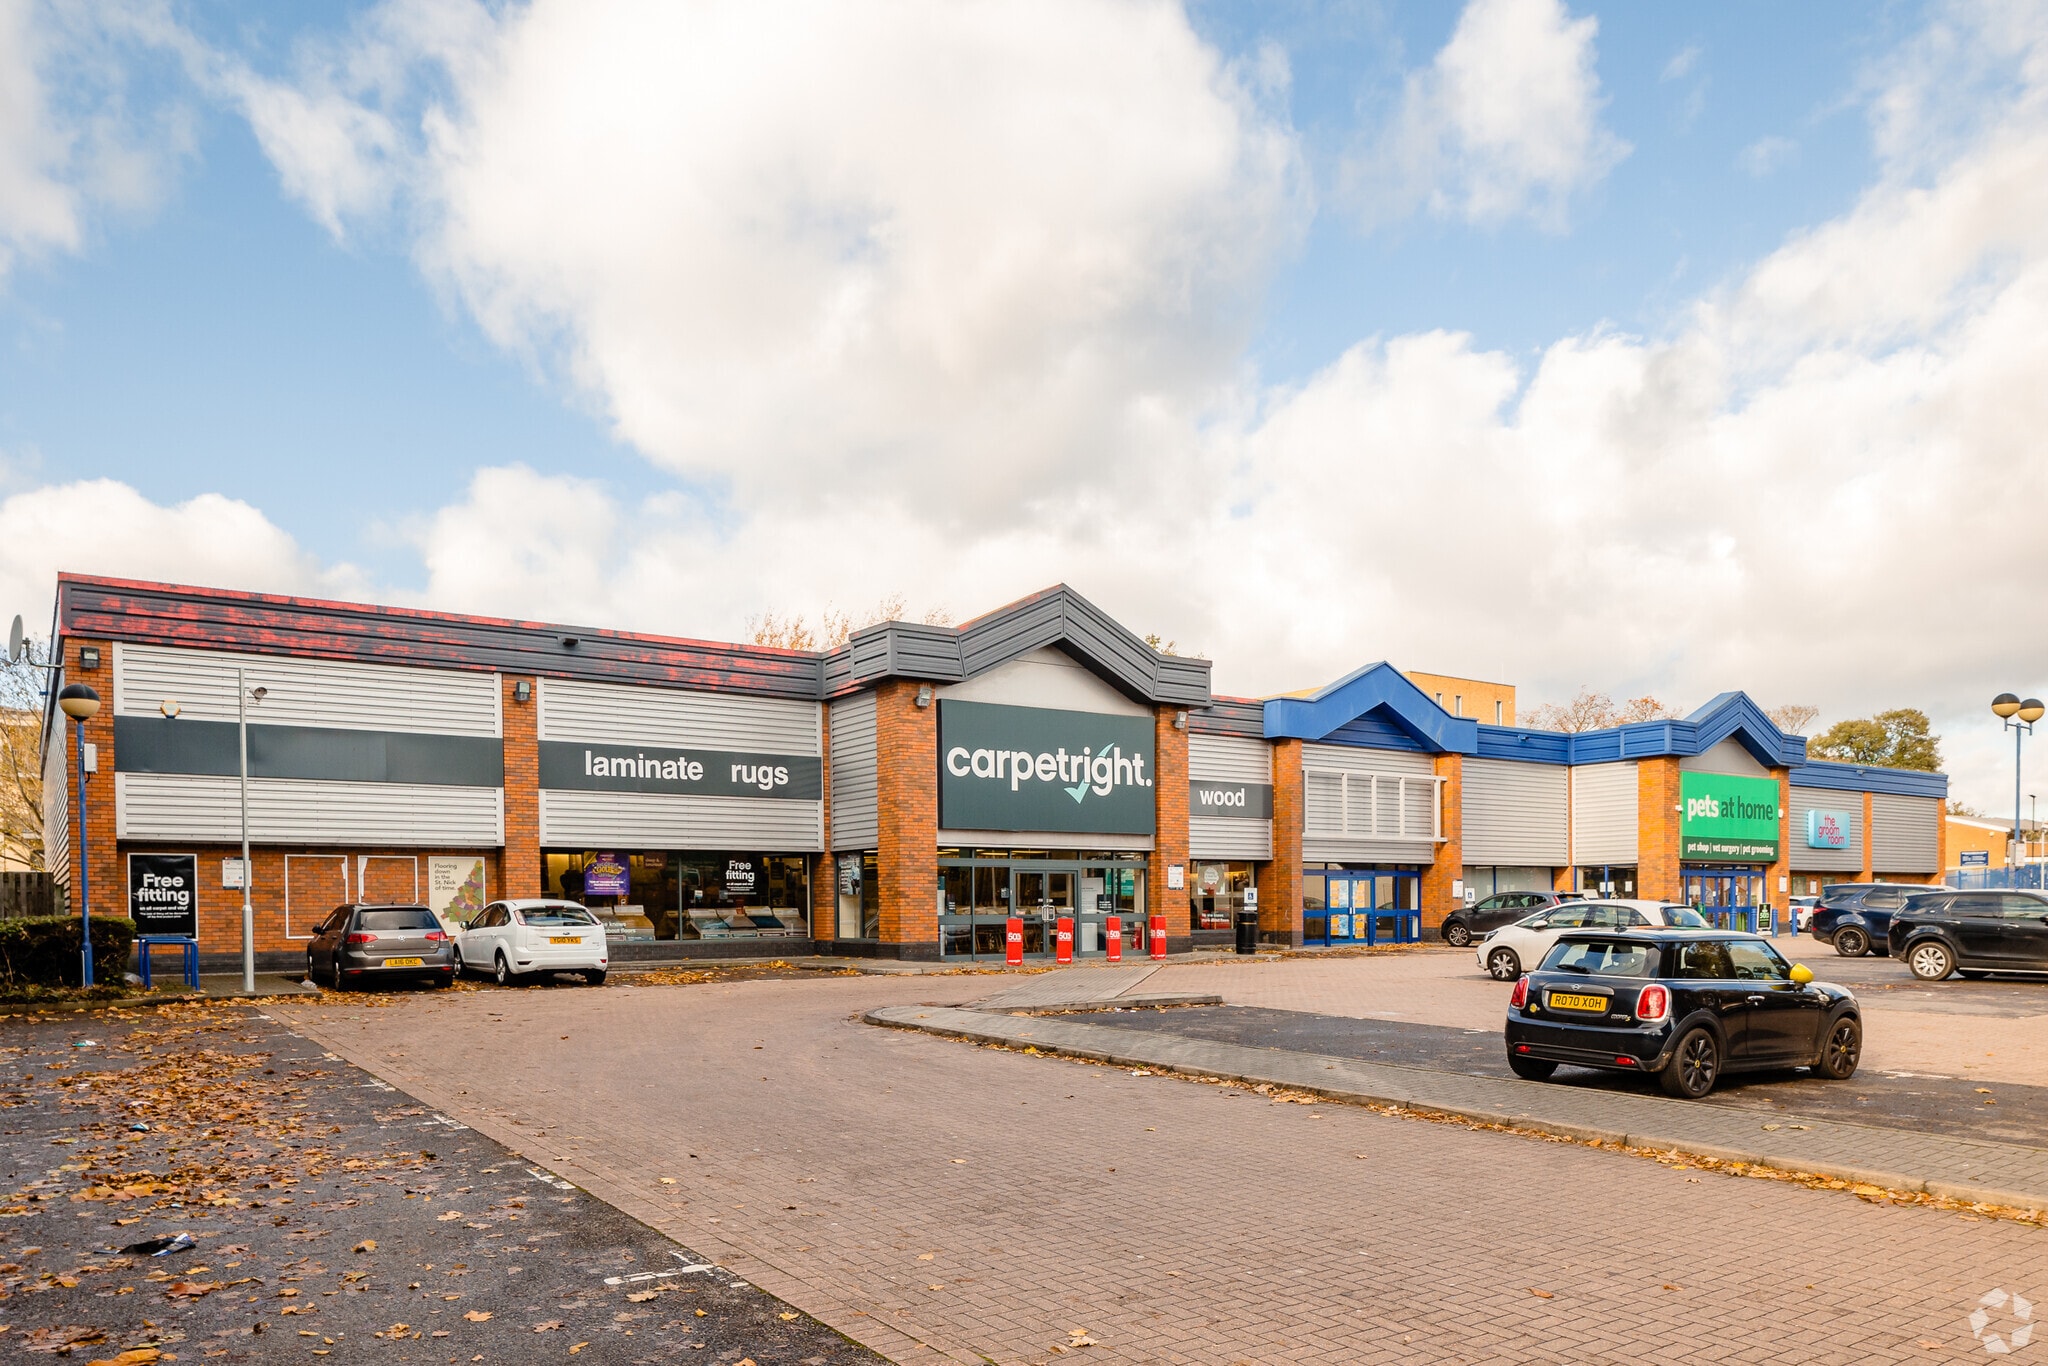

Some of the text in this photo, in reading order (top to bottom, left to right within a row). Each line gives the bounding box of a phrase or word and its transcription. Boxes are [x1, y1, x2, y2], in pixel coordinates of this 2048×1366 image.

[585, 750, 789, 790] laminate rugs
[1199, 788, 1245, 807] wood
[1687, 794, 1774, 822] pets at home
[1824, 814, 1836, 827] the
[1818, 826, 1840, 838] groom
[1827, 834, 1845, 845] room
[1687, 842, 1774, 856] pet shop vet surgery pet grooming
[729, 860, 752, 870] Free
[143, 873, 184, 887] Free
[725, 870, 755, 882] fitting
[138, 888, 190, 905] fitting
[1582, 998, 1602, 1009] XOH
